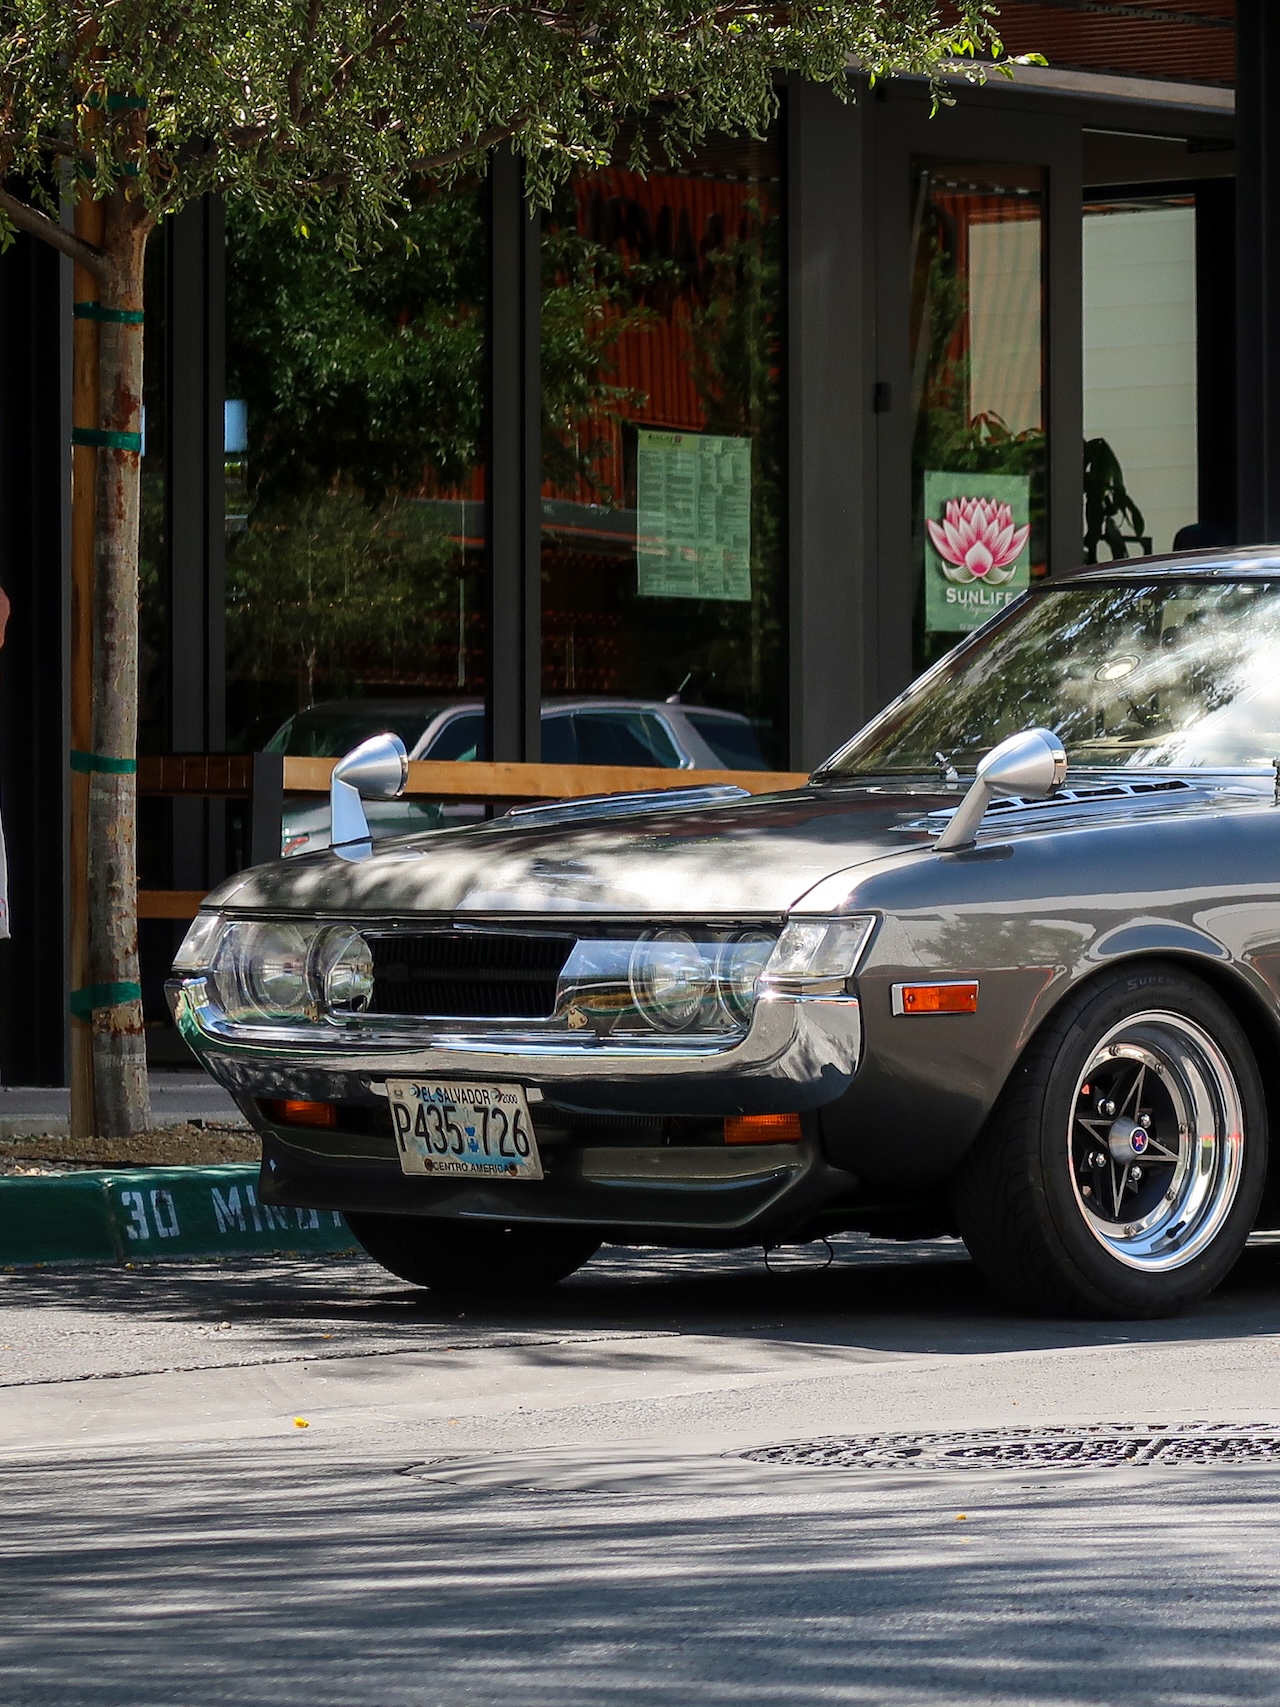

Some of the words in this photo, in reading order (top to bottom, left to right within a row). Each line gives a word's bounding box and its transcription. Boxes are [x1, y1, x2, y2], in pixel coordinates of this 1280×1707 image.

[421, 1087, 435, 1101] EL
[436, 1088, 491, 1105] SALVADOR
[433, 1161, 468, 1172] CENTRO
[470, 1163, 509, 1174] AMERICA
[121, 1189, 181, 1240] 30
